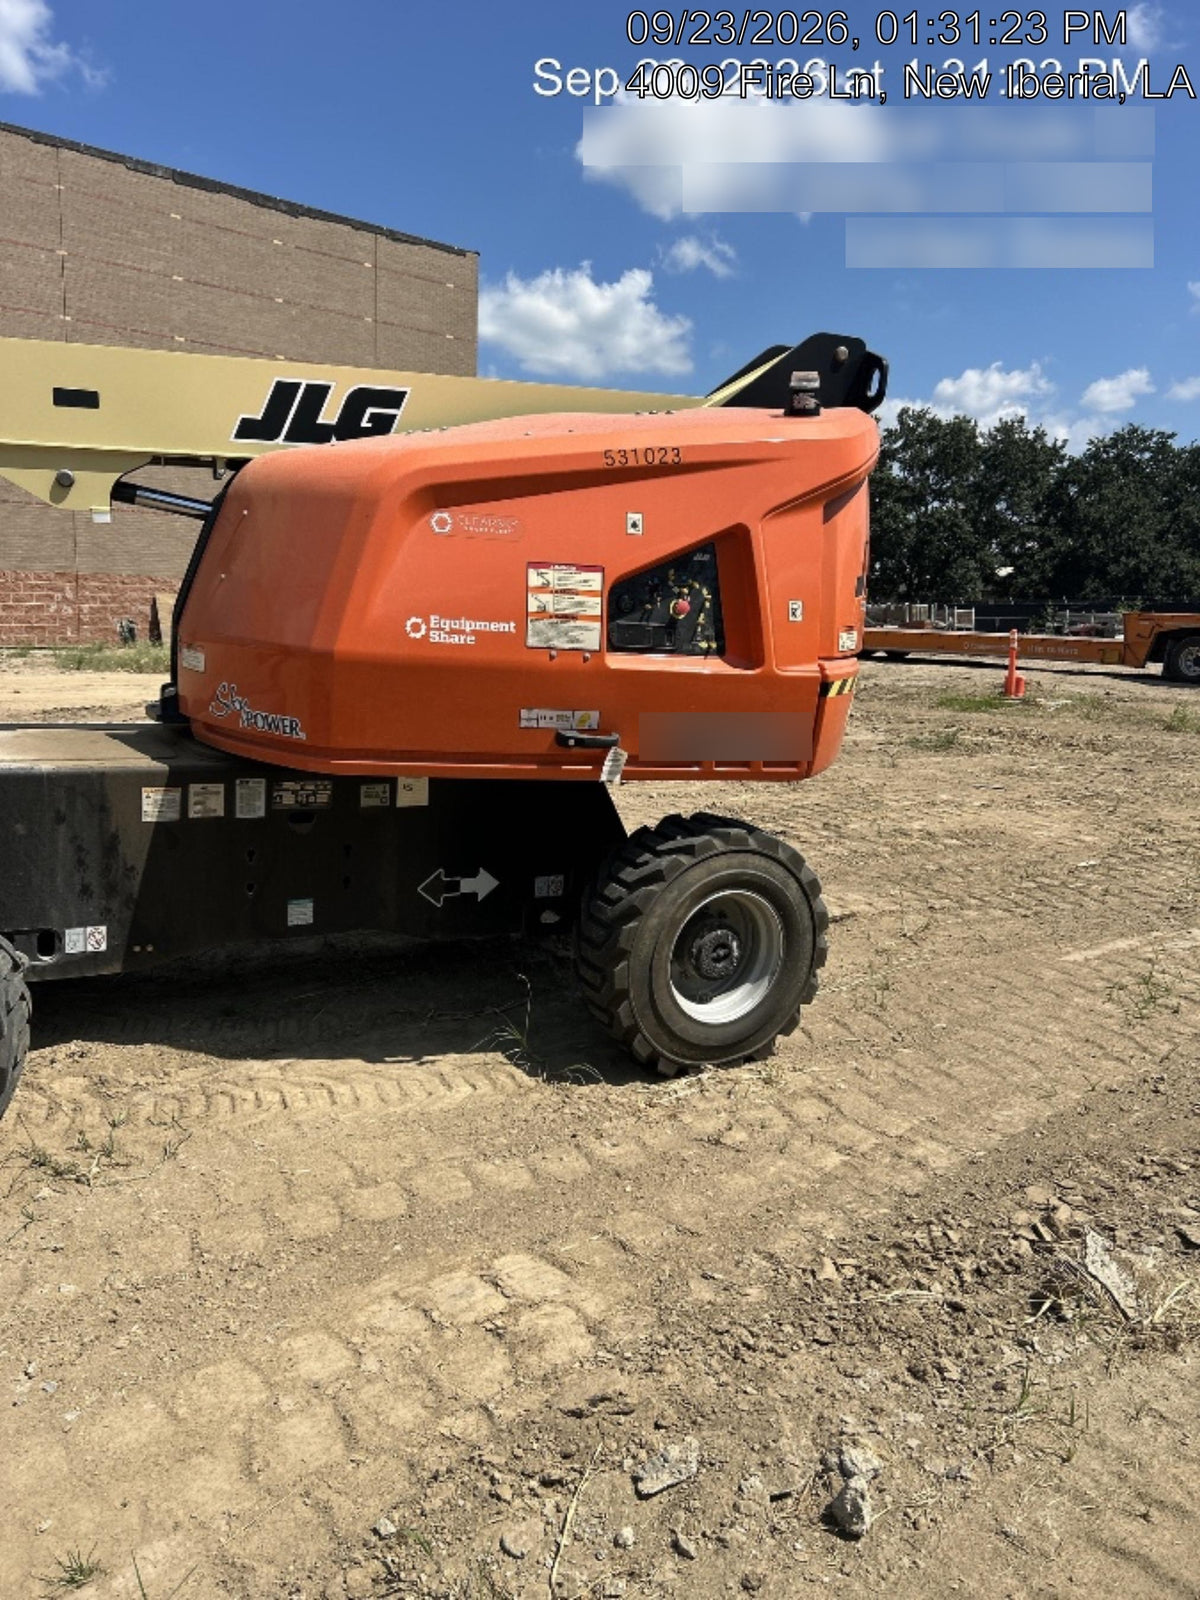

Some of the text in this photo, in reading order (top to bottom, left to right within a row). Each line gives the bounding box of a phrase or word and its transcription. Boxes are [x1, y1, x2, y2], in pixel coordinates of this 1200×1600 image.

[231, 377, 412, 445] JLG
[603, 447, 682, 467] 531023
[429, 614, 516, 633] Equipment
[429, 630, 476, 644] Share
